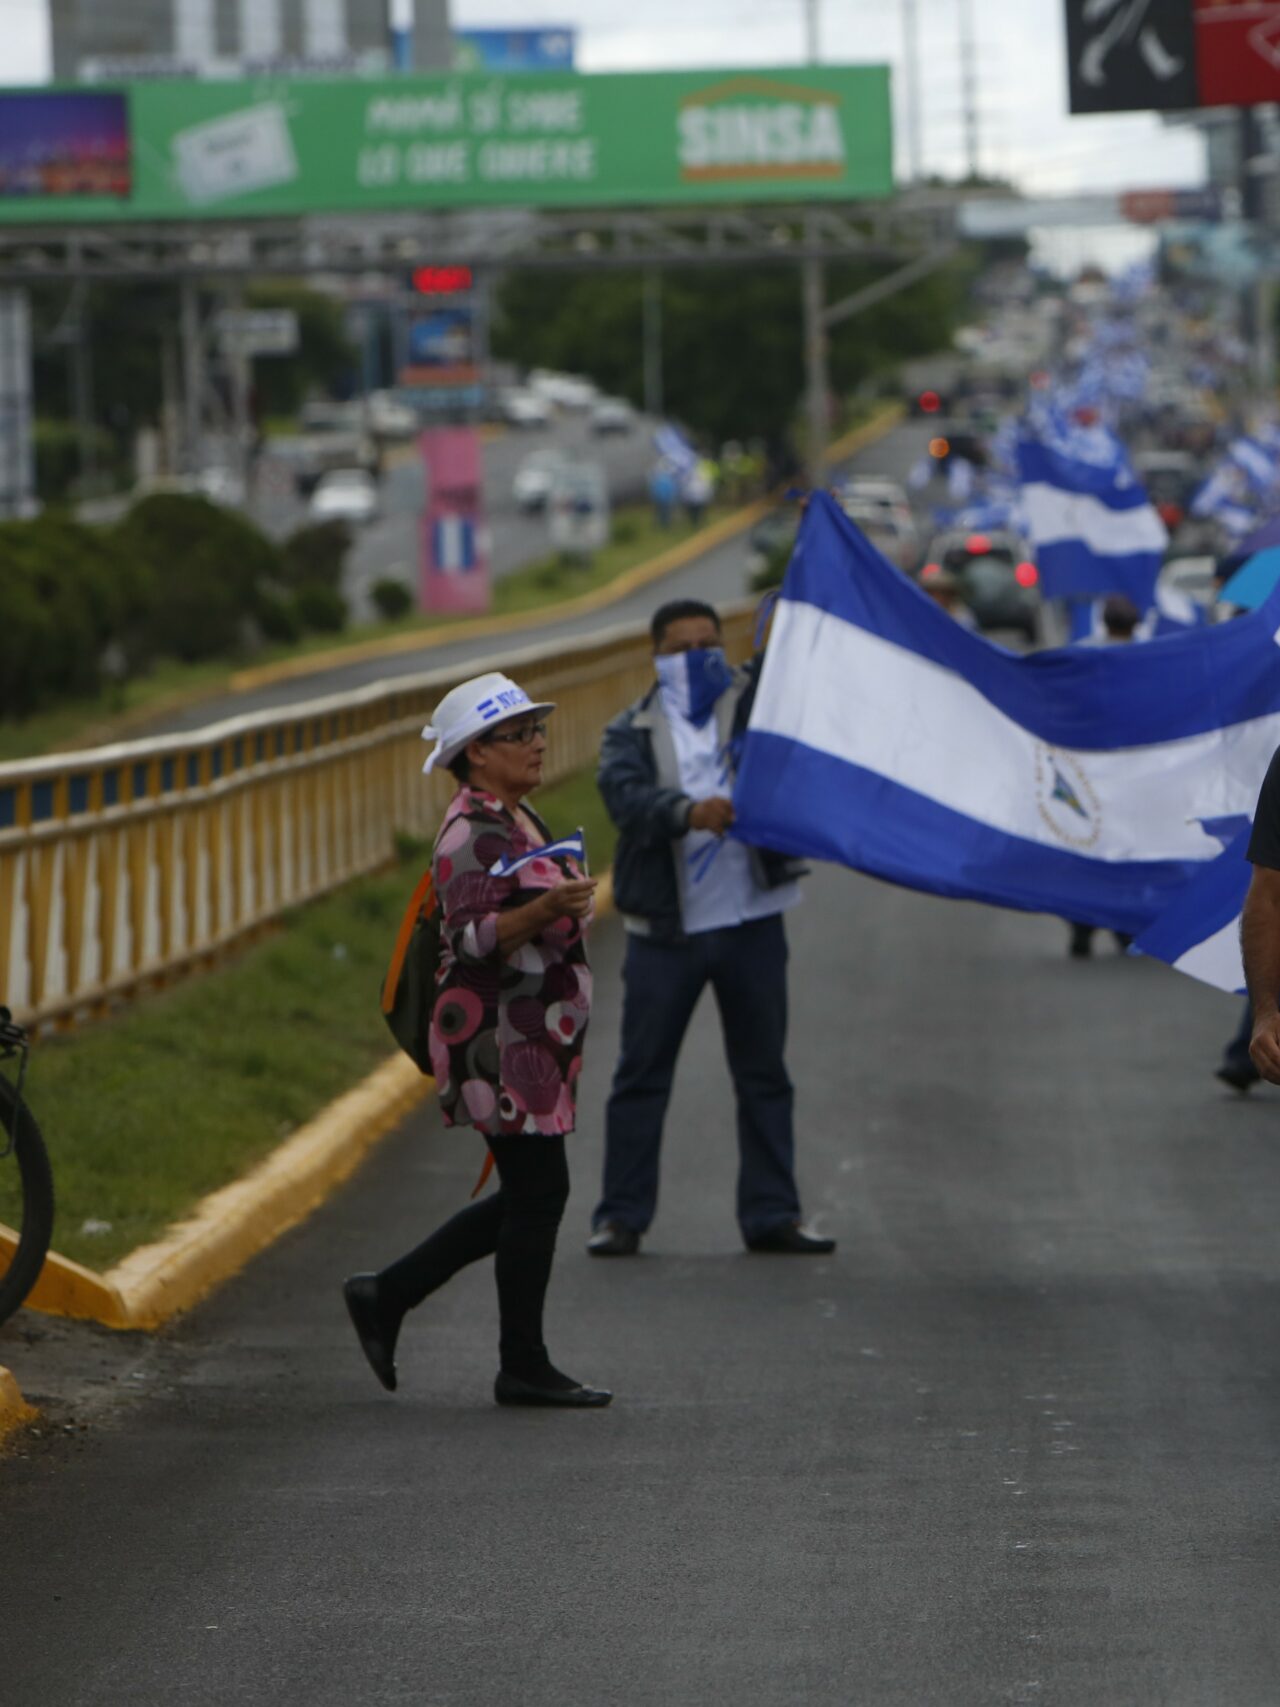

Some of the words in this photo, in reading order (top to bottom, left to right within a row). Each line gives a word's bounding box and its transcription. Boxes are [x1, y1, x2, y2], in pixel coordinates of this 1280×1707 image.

[678, 102, 843, 167] SINSA
[358, 142, 399, 186] LO
[406, 140, 470, 183] QUE
